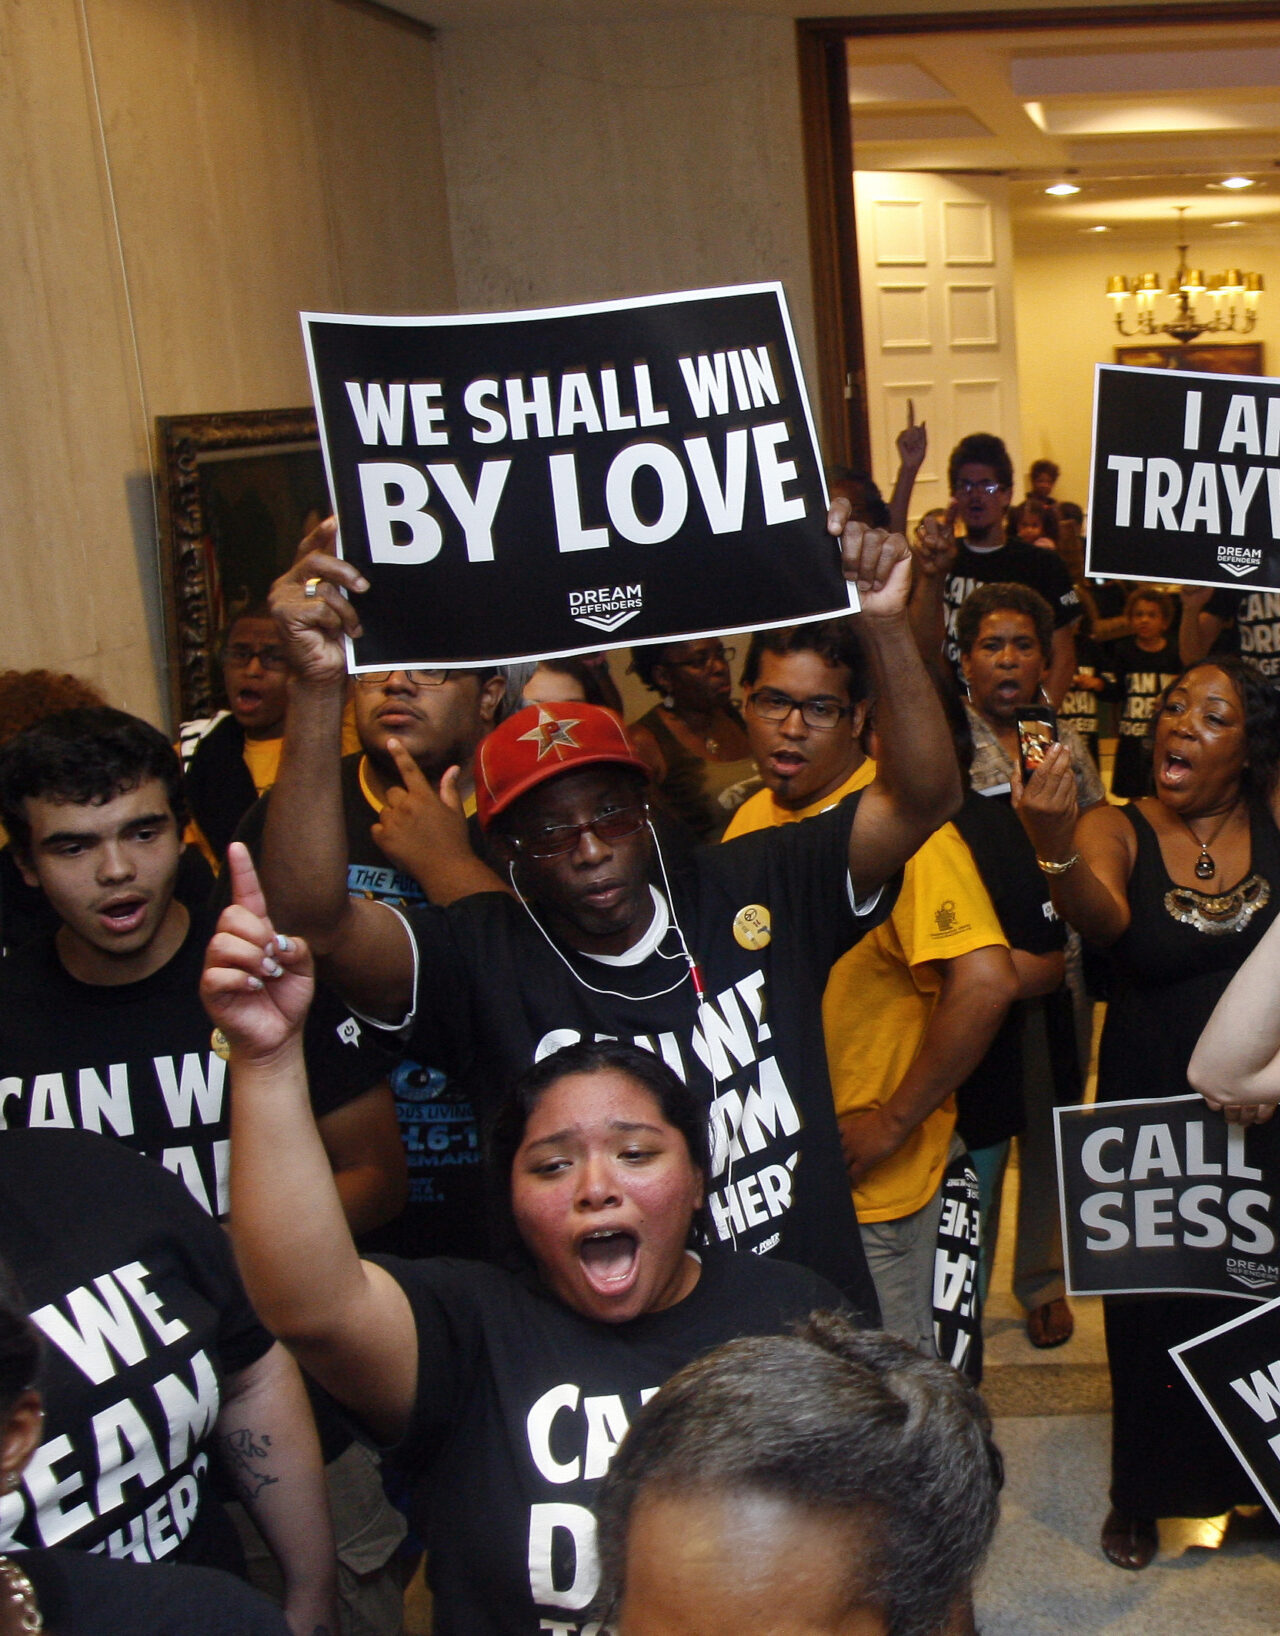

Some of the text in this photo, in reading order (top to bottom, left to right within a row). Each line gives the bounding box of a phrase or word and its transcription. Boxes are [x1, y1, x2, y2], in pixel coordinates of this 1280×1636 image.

[345, 346, 780, 446] WE SHALL WIN
[1183, 390, 1202, 450] I
[358, 421, 807, 564] BY LOVE
[1216, 555, 1261, 566] DEFENDERS
[1217, 545, 1262, 559] DREAM
[568, 583, 643, 607] DREAM
[570, 597, 643, 617] DEFENDERS
[356, 870, 387, 888] THE
[1081, 1120, 1262, 1184] CALL
[708, 1151, 798, 1241] HER
[1226, 1258, 1279, 1275] DREAM
[1226, 1266, 1279, 1282] DEFENDERS
[28, 1261, 190, 1386] WE
[526, 1383, 660, 1484] CA
